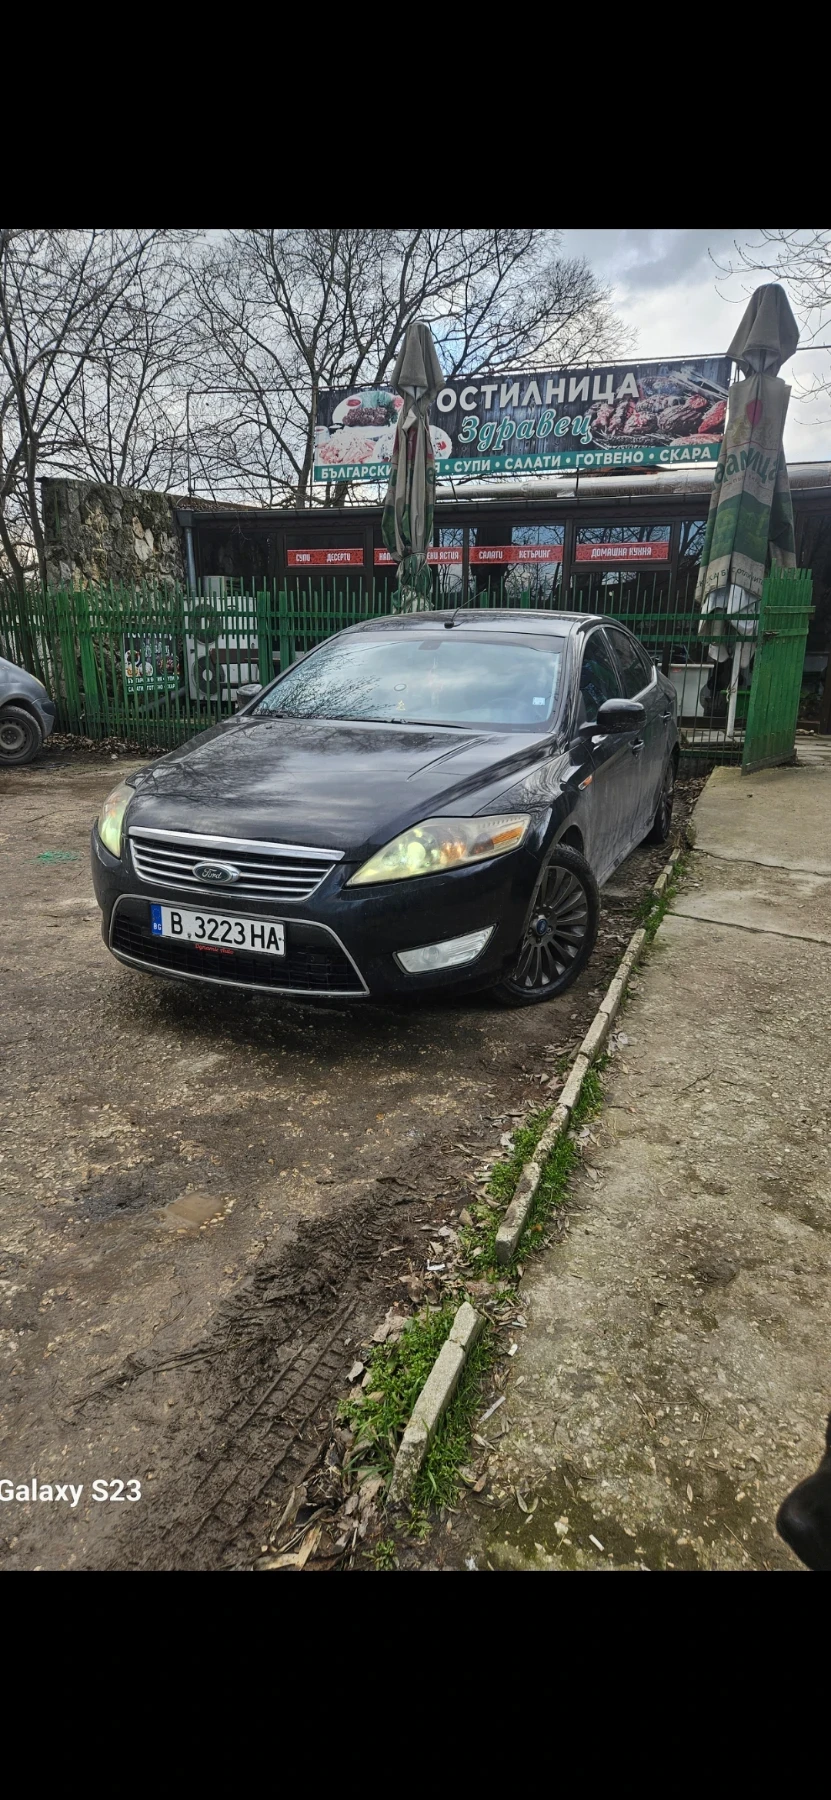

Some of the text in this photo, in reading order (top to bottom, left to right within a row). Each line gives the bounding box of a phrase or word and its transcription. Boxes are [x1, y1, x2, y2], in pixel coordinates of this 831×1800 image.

[437, 372, 639, 413] ОСТИЛНИЦА
[458, 408, 593, 451] Здравец
[454, 459, 491, 473] СУПИ
[504, 455, 561, 470] САЛАТИ
[576, 451, 644, 467] ГОТВЕНО
[660, 447, 711, 461] СКАРА
[326, 552, 351, 562] ДЕСЕРТИ
[478, 550, 503, 559] САЛАТИ
[591, 548, 627, 558] ДОМАШНА
[201, 867, 222, 879] Ford
[153, 911, 279, 951] BG B 3223 HA
